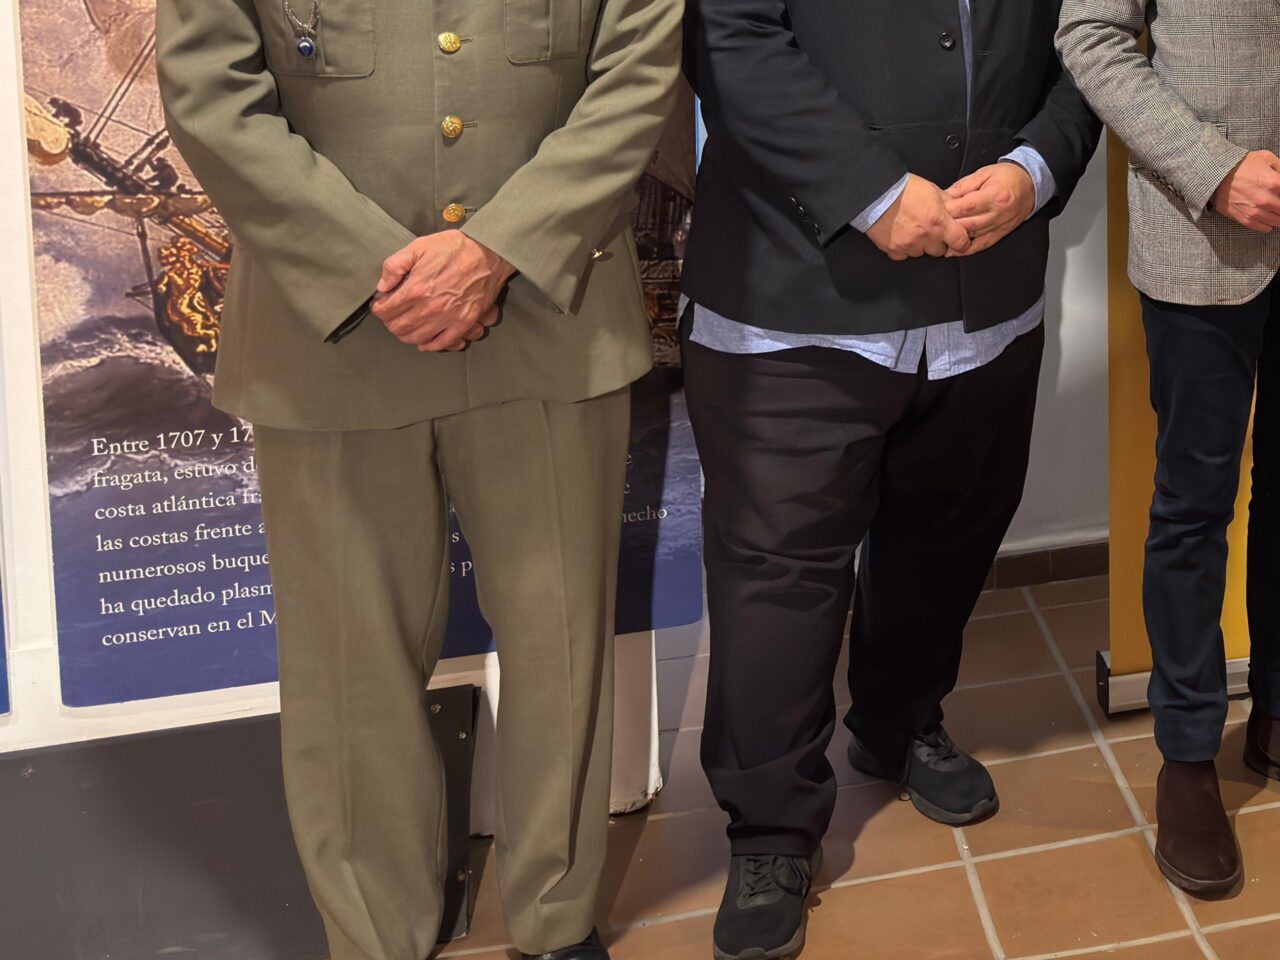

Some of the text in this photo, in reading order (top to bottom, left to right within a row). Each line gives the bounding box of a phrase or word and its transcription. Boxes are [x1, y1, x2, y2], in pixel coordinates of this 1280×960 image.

[91, 425, 254, 457] Entre 1707 y 17
[93, 455, 257, 491] fragata, estuvo d
[95, 487, 262, 520] costa atlántica fr
[96, 534, 123, 552] las
[130, 530, 188, 548] costas
[194, 523, 252, 541] frente
[98, 559, 206, 583] numerosos
[212, 552, 270, 573] buque
[100, 582, 273, 616] ha quedado plasm
[102, 609, 277, 646] conservan en el M
